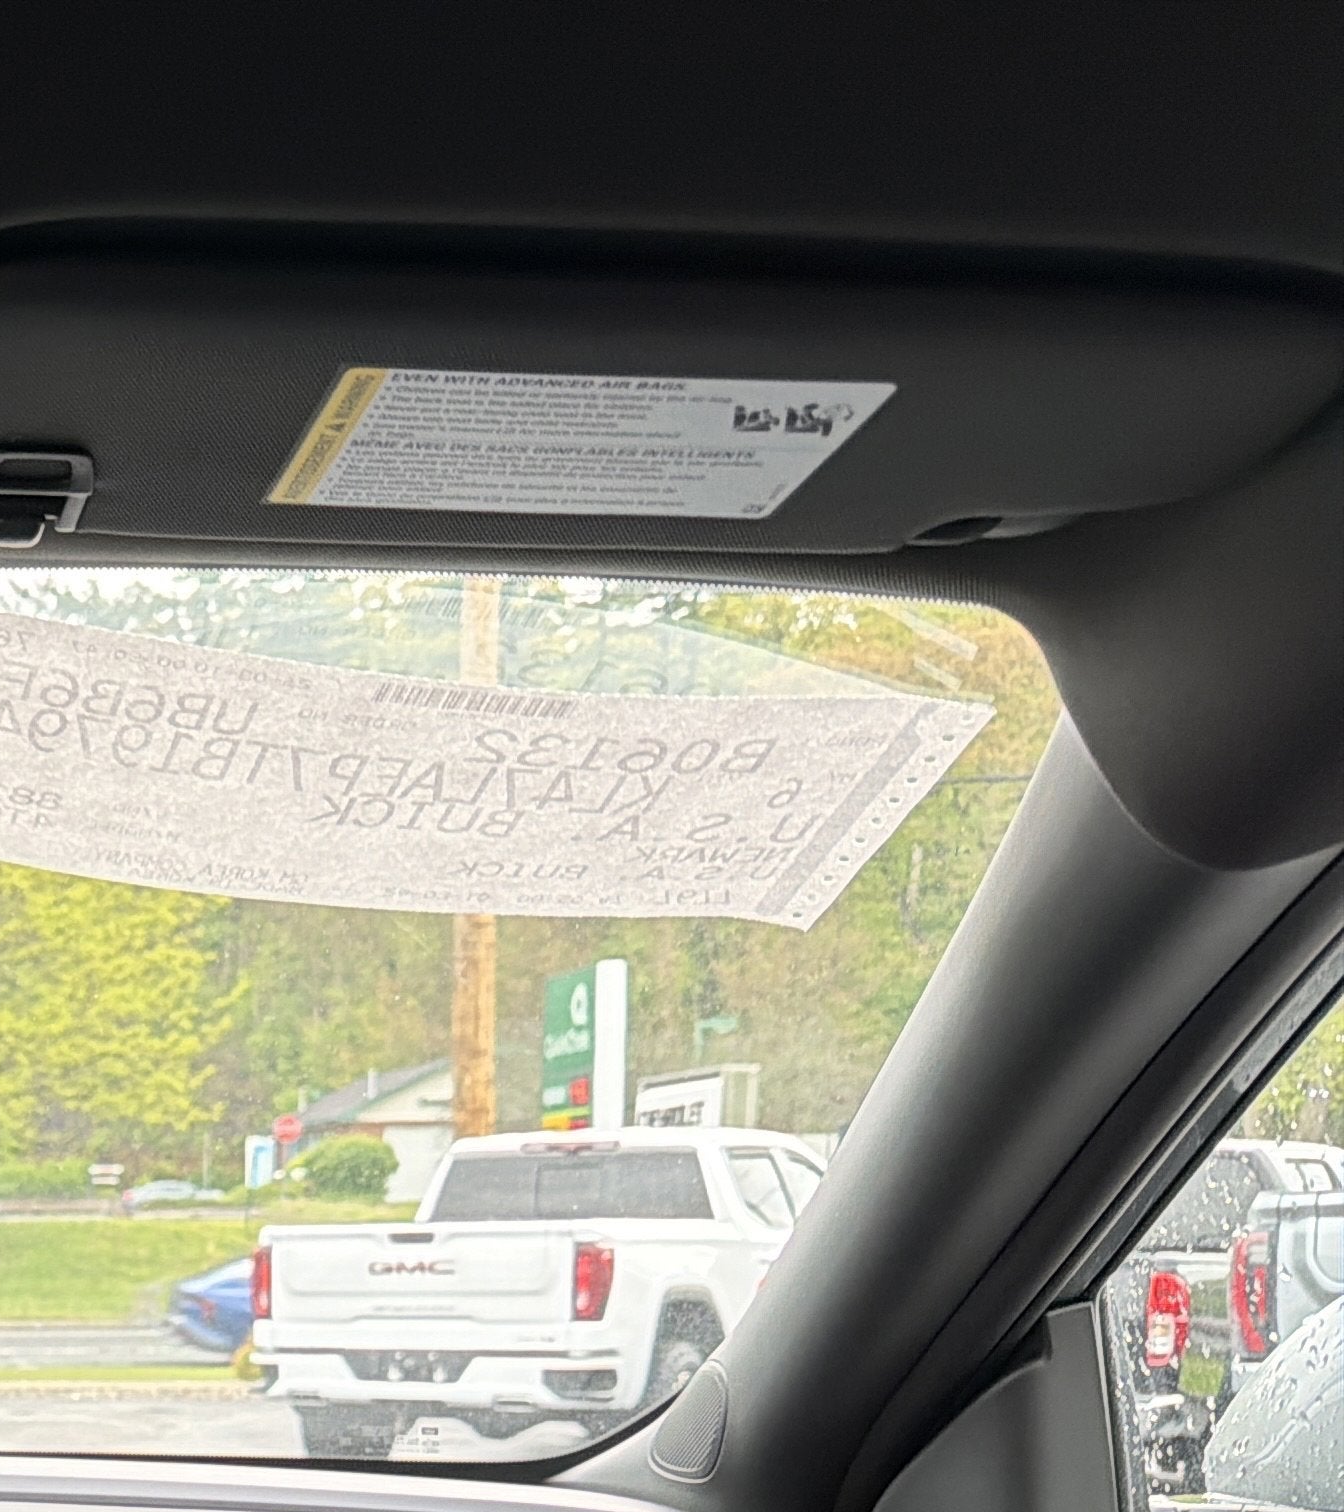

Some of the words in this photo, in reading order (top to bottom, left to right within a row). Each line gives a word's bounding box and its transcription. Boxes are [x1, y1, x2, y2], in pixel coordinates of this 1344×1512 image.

[391, 373, 439, 383] EVEN
[444, 375, 490, 386] WITH
[494, 377, 594, 389] ADVANCED
[598, 380, 632, 390] AIR
[368, 1260, 455, 1275] GMC
